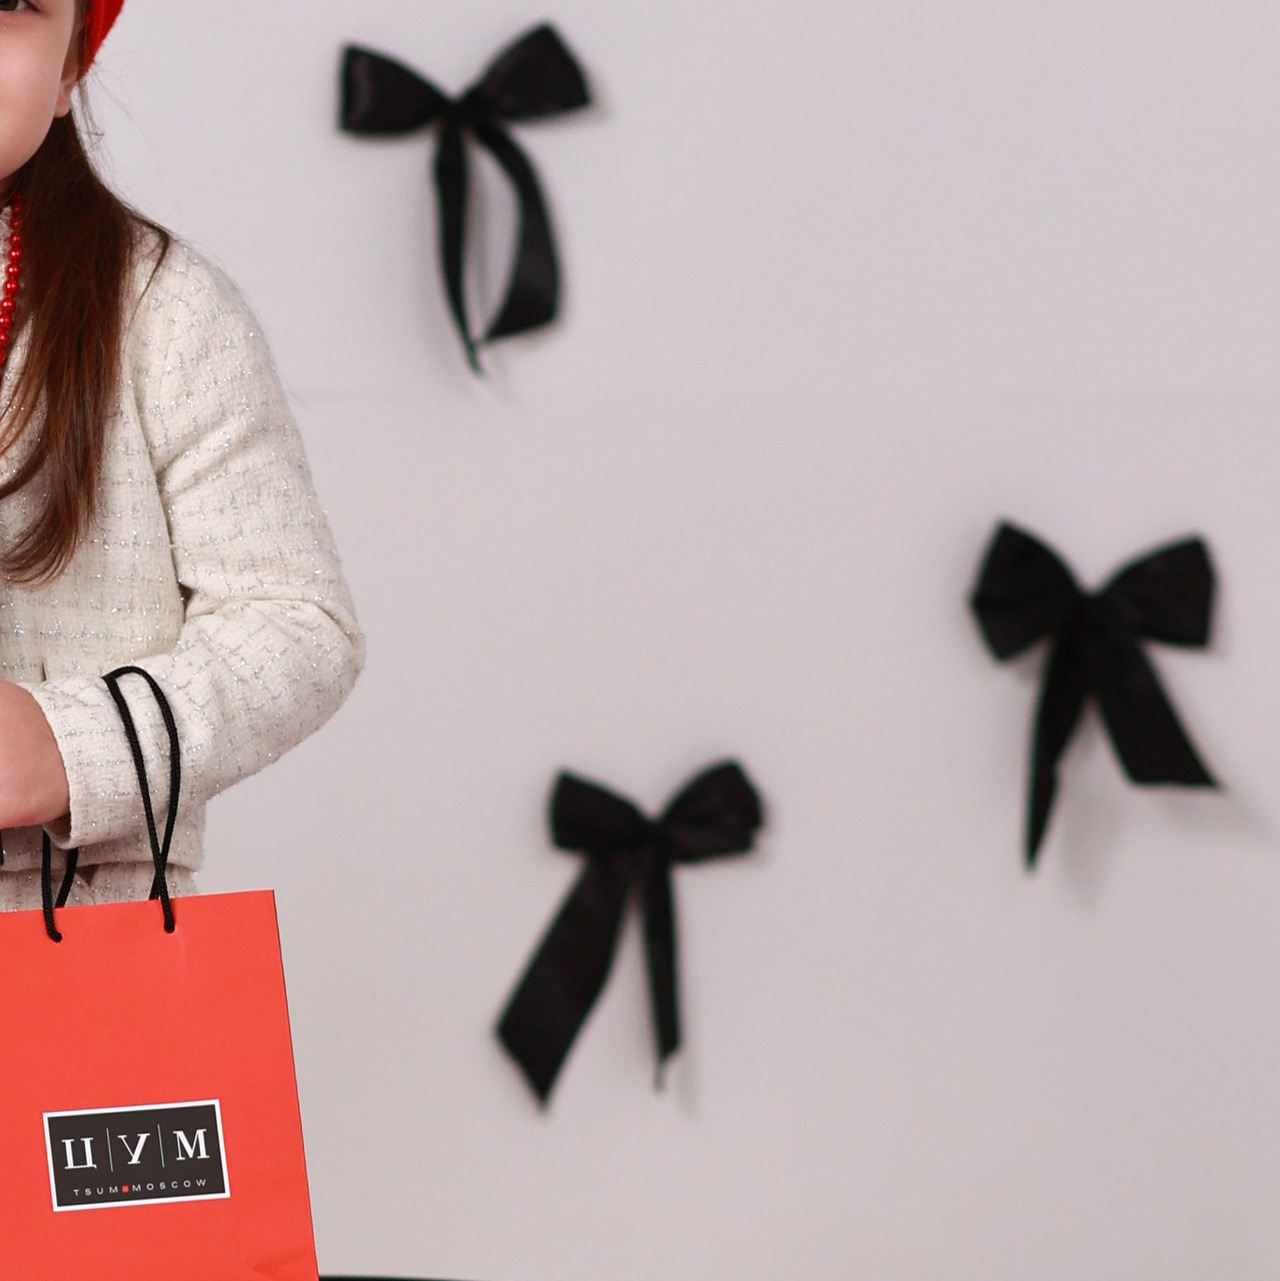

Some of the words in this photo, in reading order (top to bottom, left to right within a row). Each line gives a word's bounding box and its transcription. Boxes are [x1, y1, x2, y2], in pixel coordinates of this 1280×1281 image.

[61, 1128, 210, 1170] ЦУМ
[73, 1186, 118, 1196] TSUM
[132, 1179, 206, 1192] MOSCOW
